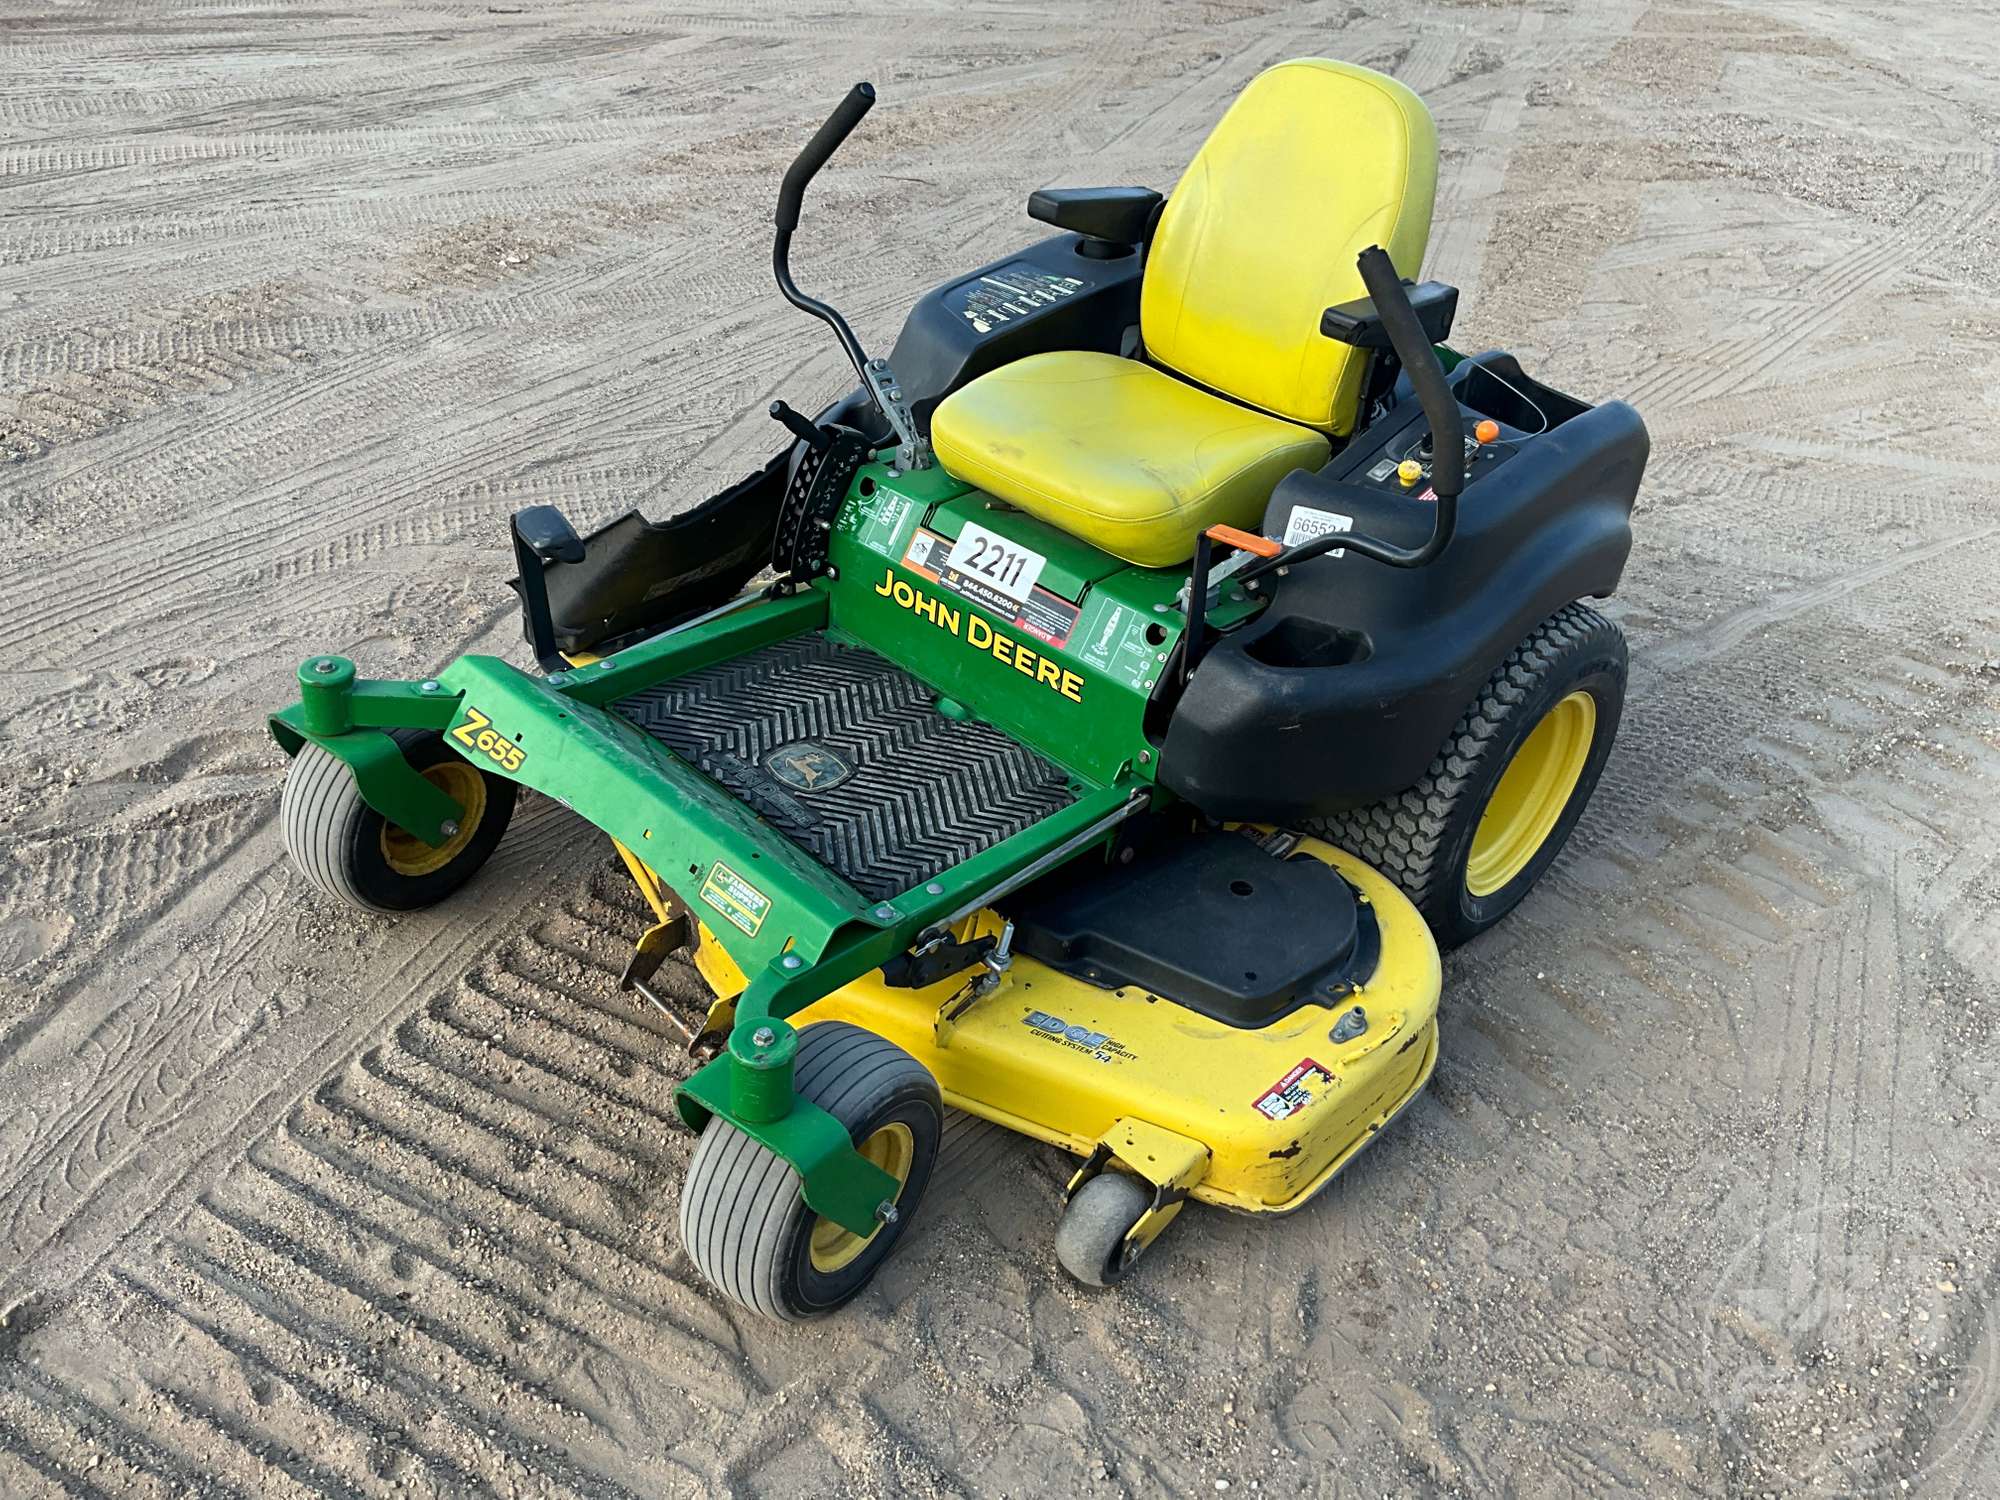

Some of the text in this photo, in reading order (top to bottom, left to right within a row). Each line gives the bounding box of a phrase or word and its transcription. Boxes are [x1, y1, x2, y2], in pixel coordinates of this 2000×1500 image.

[1293, 517, 1344, 535] 66552
[964, 536, 1028, 587] 2211
[875, 569, 960, 636] JOHN
[966, 613, 1085, 703] DEERE
[451, 707, 527, 772] Z655
[1021, 1009, 1111, 1050] EDGE
[1030, 1028, 1112, 1063] CUTTING SYSTEM 54
[1106, 1040, 1126, 1050] HIGH
[1101, 1044, 1138, 1061] CAPACITY
